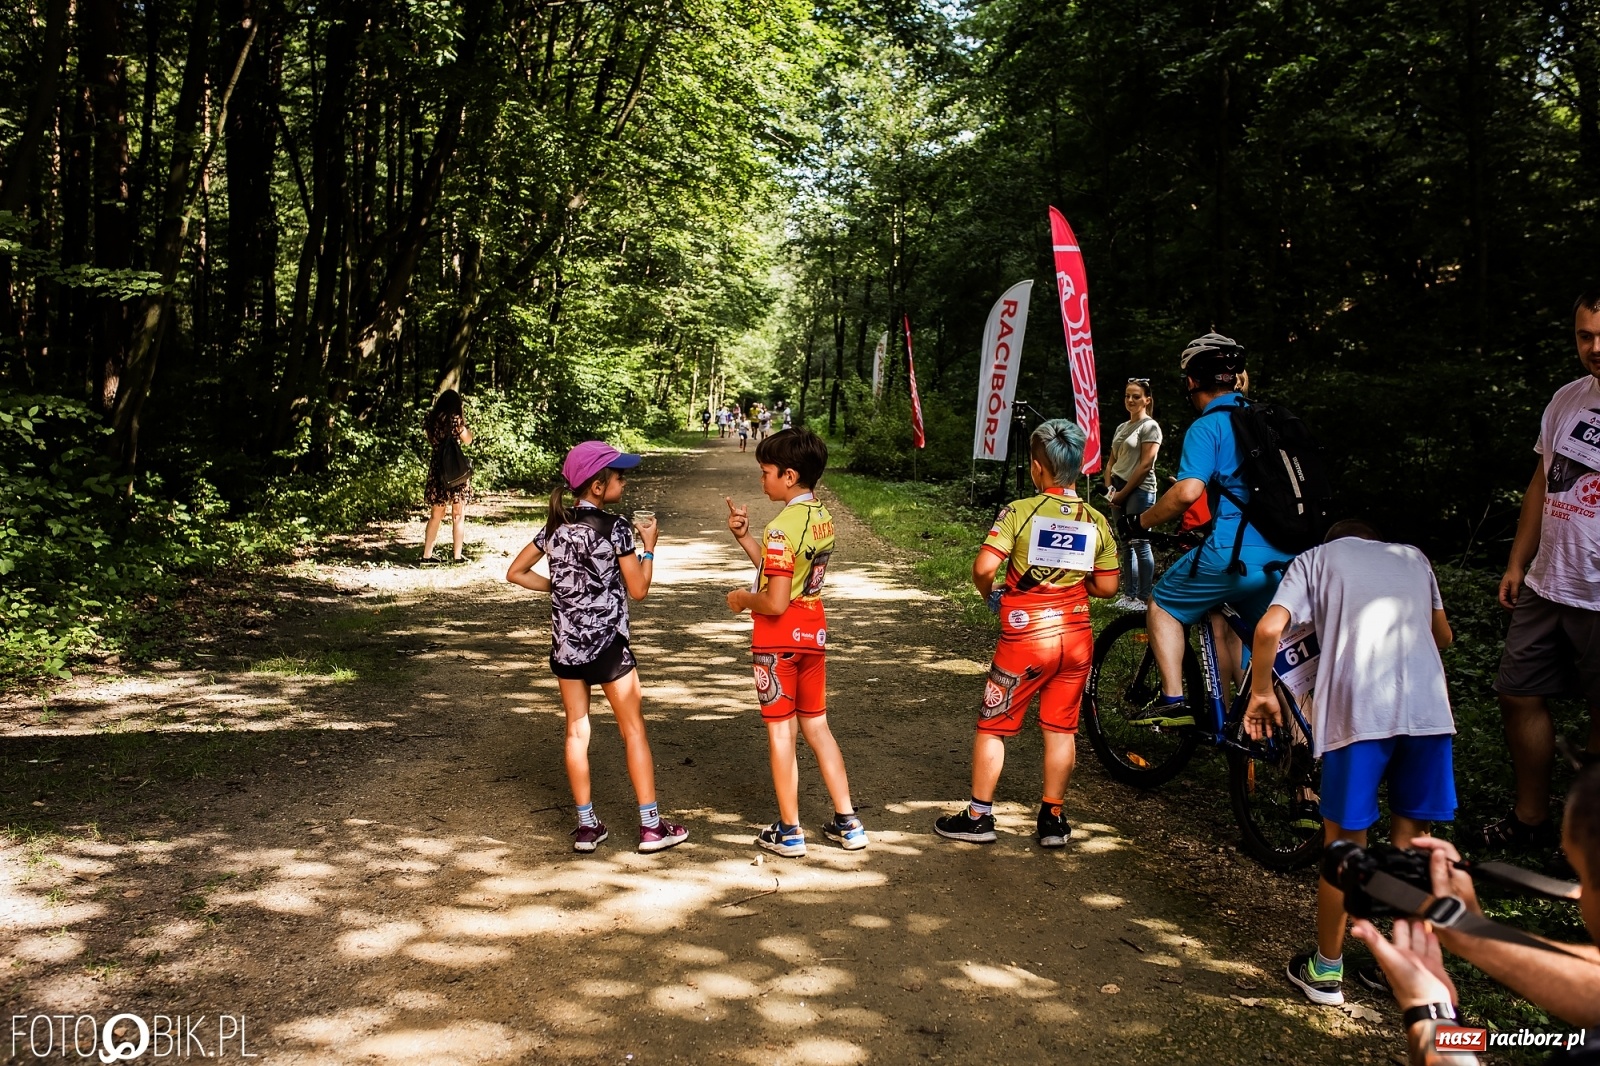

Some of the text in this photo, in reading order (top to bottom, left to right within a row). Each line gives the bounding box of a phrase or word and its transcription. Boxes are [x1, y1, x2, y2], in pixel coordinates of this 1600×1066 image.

[983, 299, 1018, 455] RACIBÓRZ
[1583, 427, 1600, 444] 64
[1050, 533, 1074, 549] 22
[1285, 642, 1309, 666] 61
